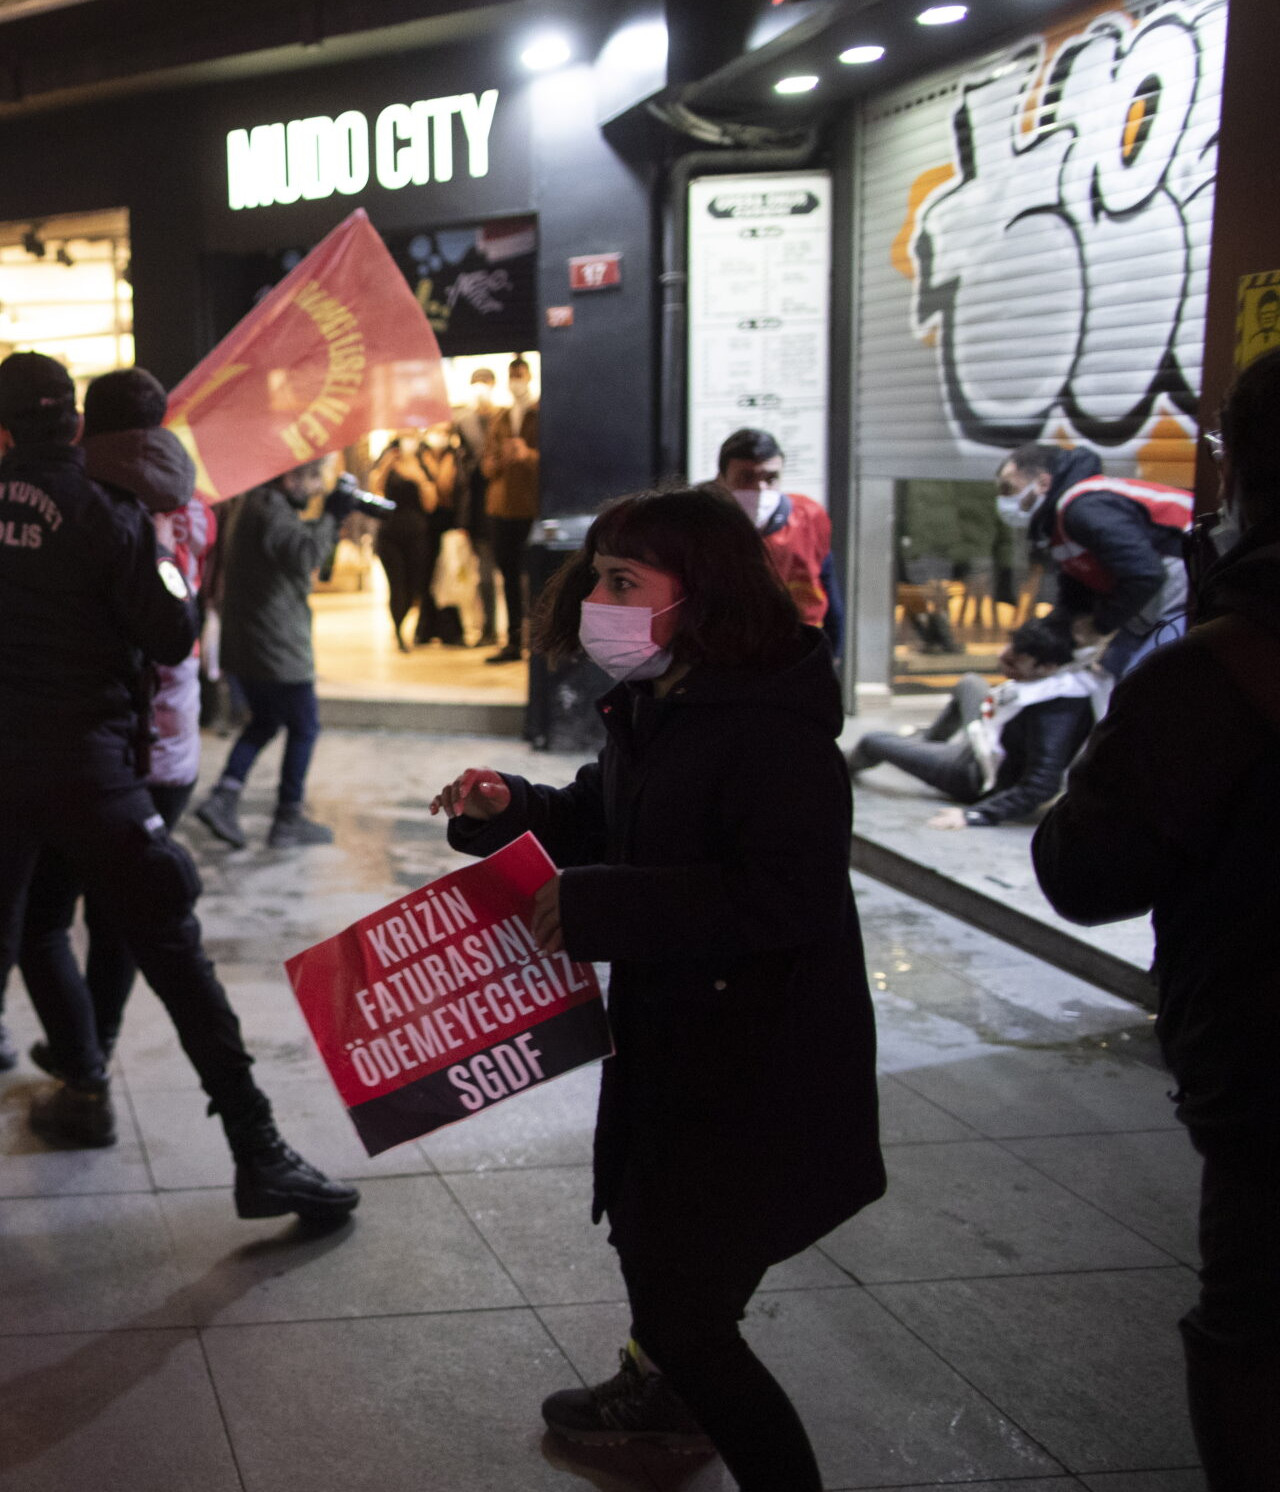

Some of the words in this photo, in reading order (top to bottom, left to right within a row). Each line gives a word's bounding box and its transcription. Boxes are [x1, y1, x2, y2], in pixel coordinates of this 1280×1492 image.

[227, 110, 370, 211] MUDO
[375, 89, 500, 190] CITY
[355, 913, 540, 1031] FATURASINI
[366, 885, 478, 969] KRİZİN
[447, 1031, 545, 1111] SGDF
